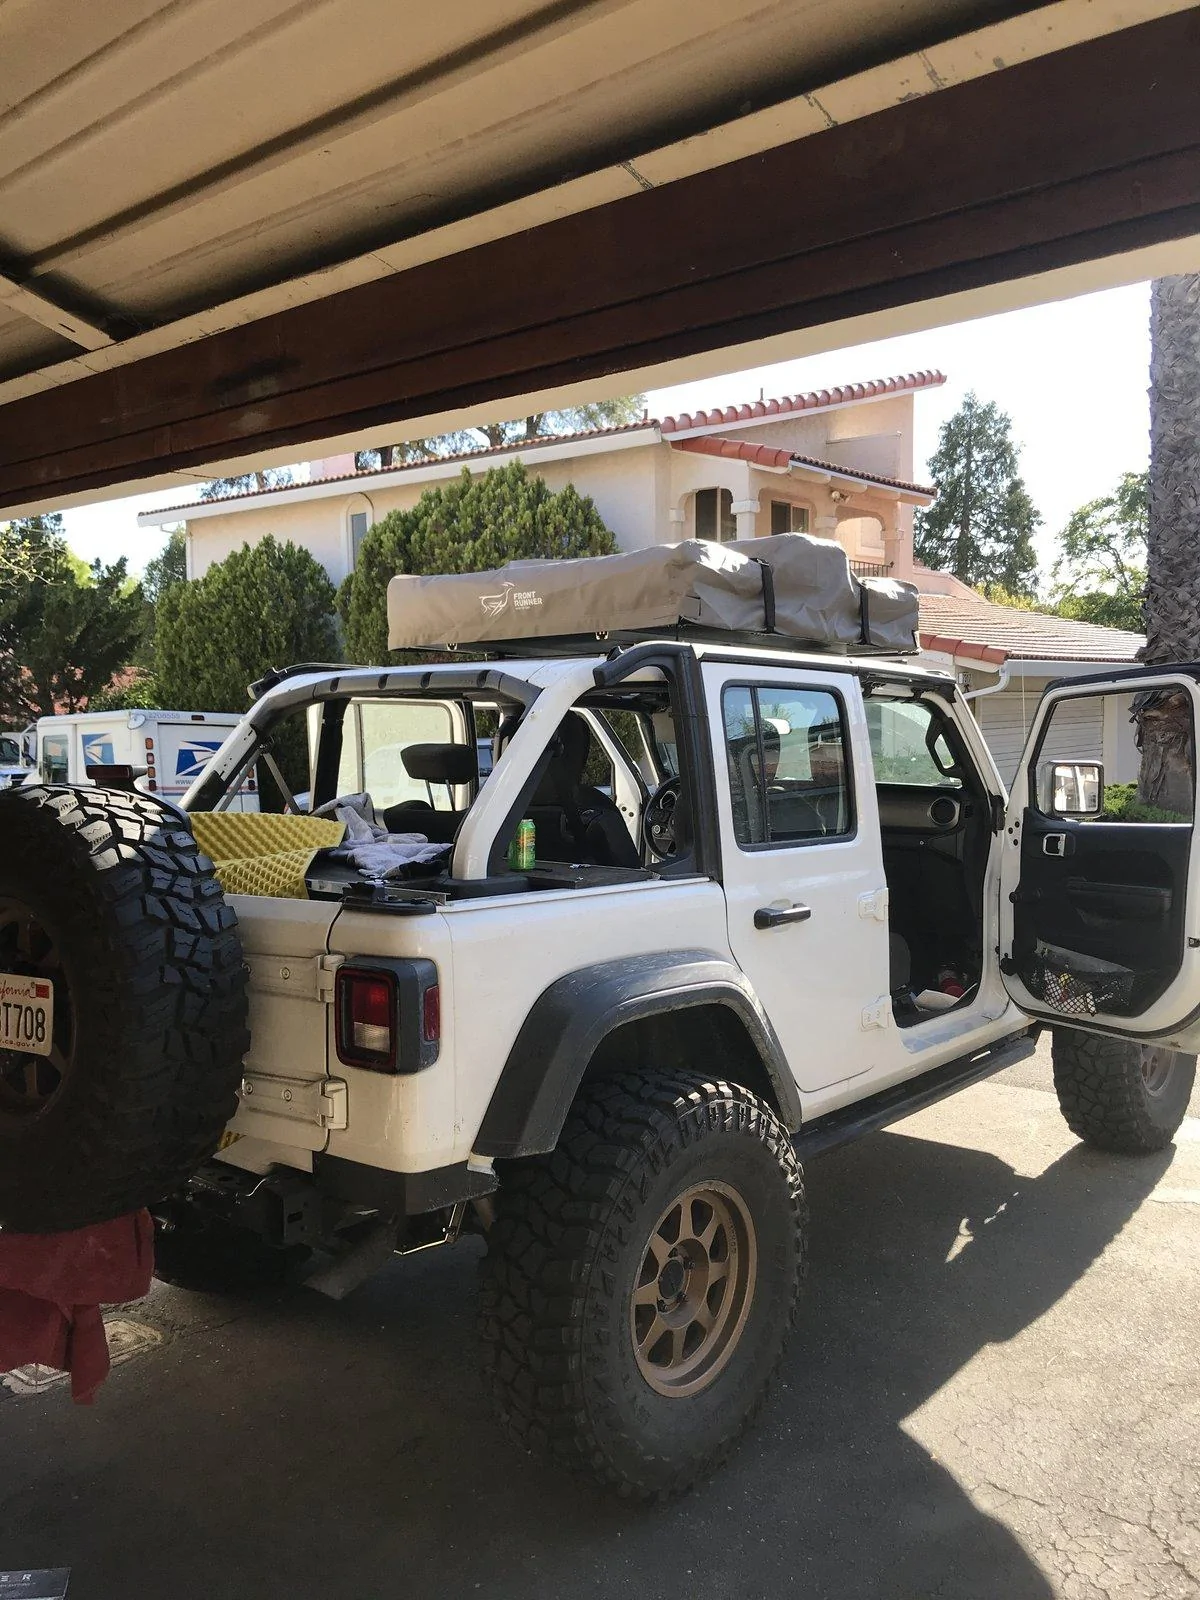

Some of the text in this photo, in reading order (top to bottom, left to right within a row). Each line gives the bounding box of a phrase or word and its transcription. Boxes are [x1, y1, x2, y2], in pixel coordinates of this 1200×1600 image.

[513, 590, 536, 600] FRONT
[513, 597, 543, 607] RUNNER
[0, 1002, 46, 1042] T708
